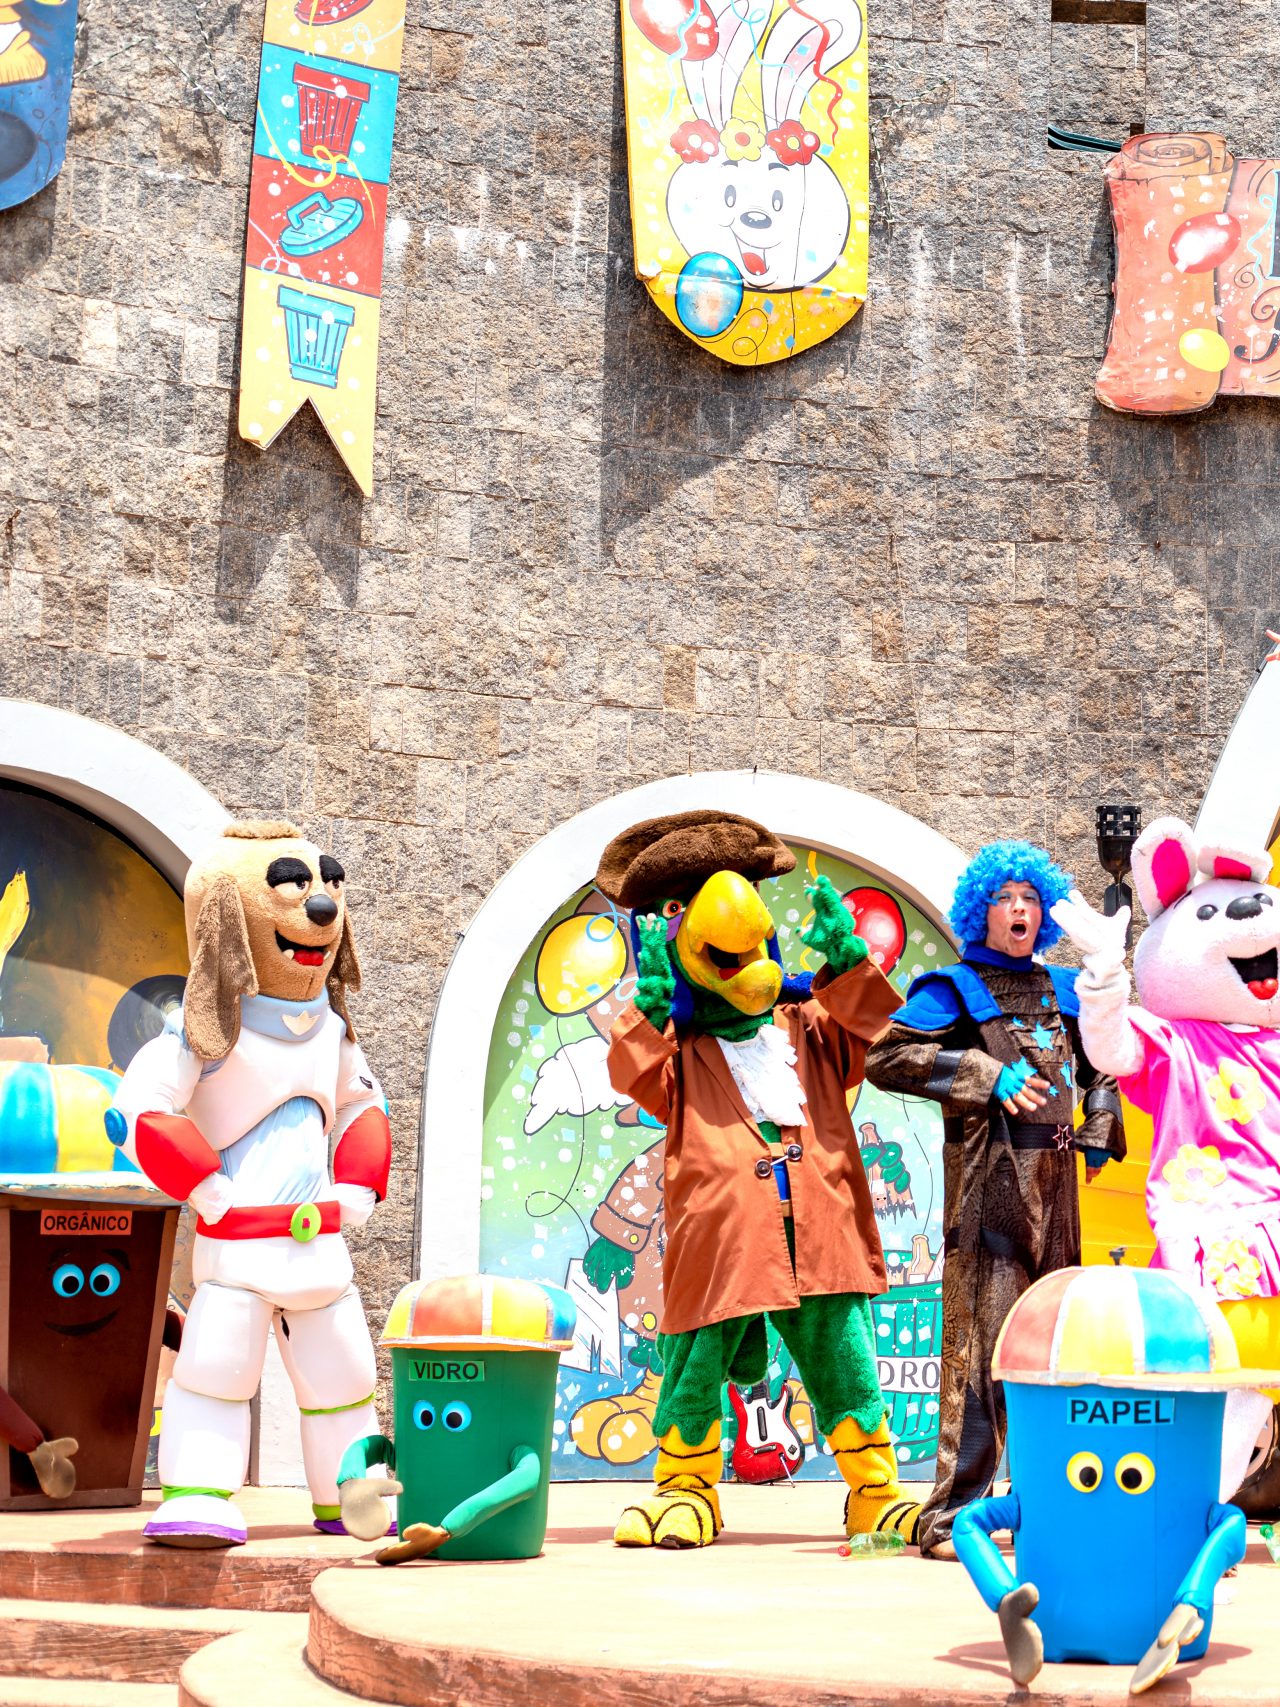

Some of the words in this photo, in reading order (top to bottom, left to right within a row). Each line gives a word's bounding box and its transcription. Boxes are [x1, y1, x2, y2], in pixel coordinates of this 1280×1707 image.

[43, 1211, 129, 1231] ORGÂNICO
[414, 1361, 479, 1380] VIDRO
[1070, 1399, 1171, 1425] PAPEL
